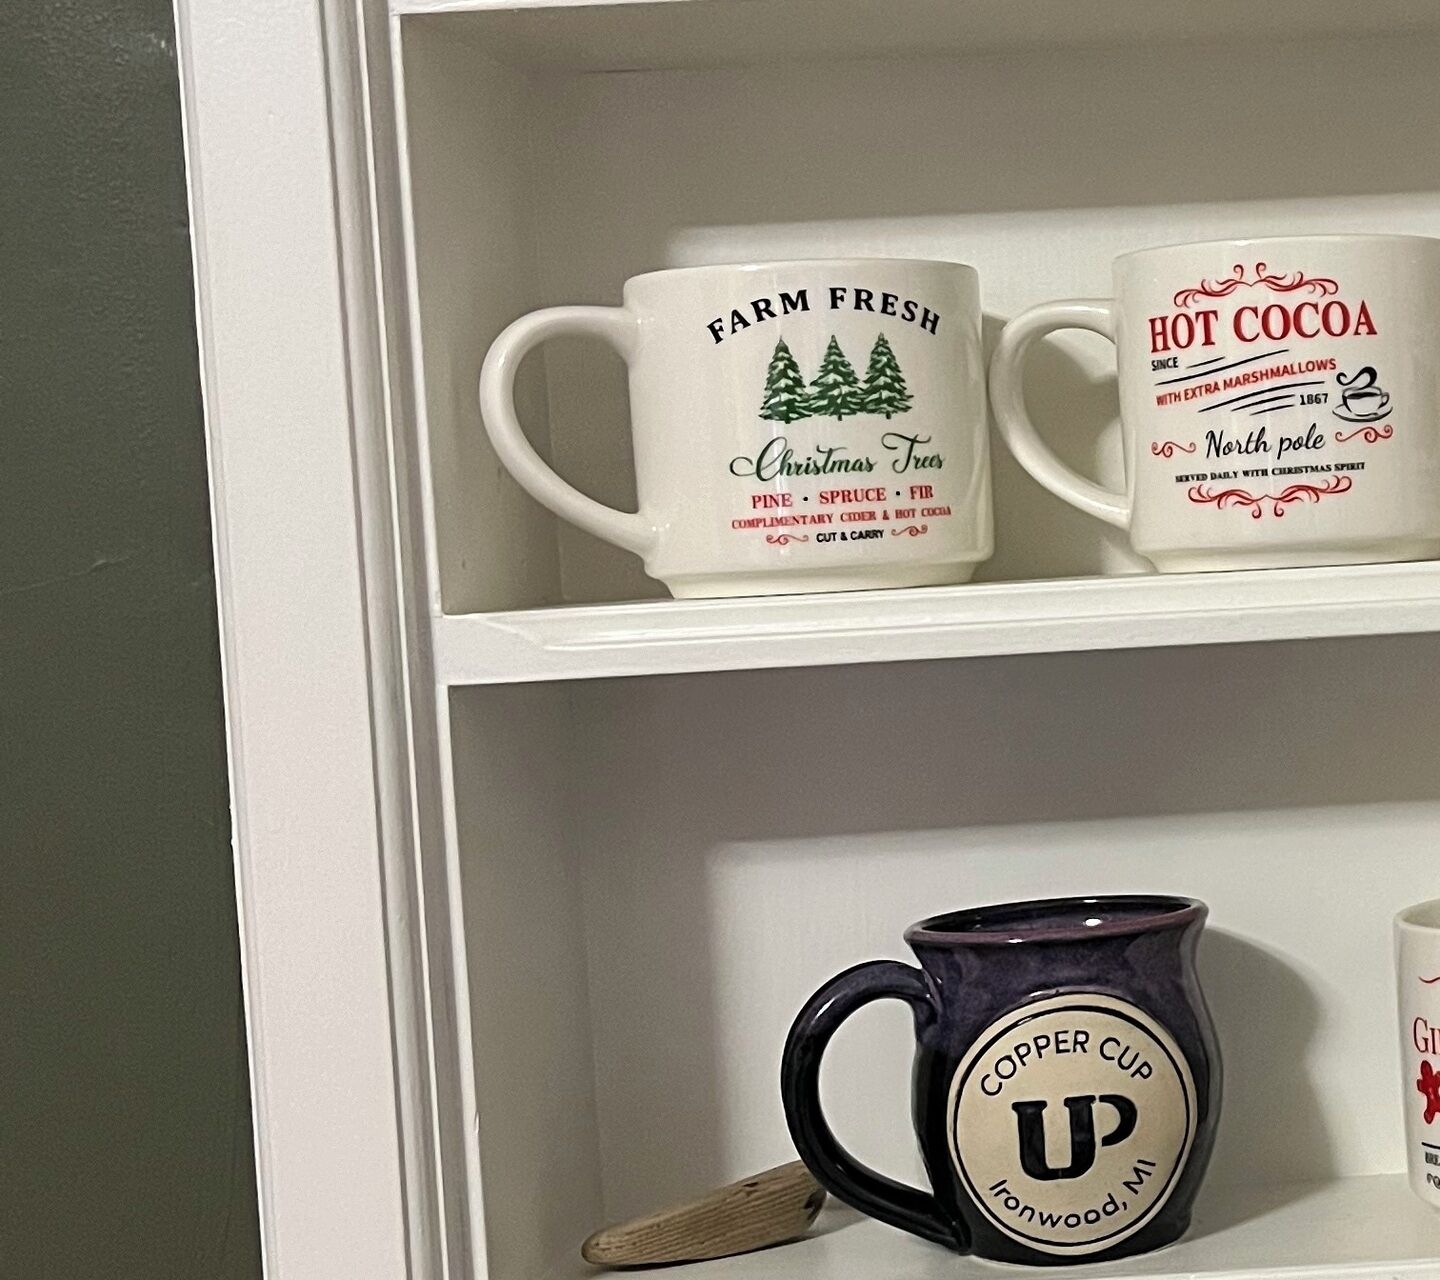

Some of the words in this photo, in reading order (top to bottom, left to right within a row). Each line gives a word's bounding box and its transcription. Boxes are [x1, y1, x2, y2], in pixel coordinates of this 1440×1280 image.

[707, 288, 810, 344] FARM
[829, 287, 941, 335] FRESH
[1148, 310, 1218, 354] HOT
[1232, 299, 1378, 343] COCOA
[1151, 357, 1179, 372] SINCE
[1155, 390, 1182, 406] WITH
[1184, 382, 1221, 402] EXTRA
[1223, 358, 1337, 393] MARSHMALLOWS
[1299, 393, 1329, 405] 1867
[729, 436, 878, 482] Christmas
[881, 432, 945, 474] Trees
[1205, 426, 1270, 459] North
[1277, 423, 1326, 460] pole
[1175, 472, 1208, 483] SERVED
[1210, 470, 1238, 481] DAILY
[1243, 468, 1269, 477] WITH
[1271, 463, 1332, 476] CHRISTMAS
[1334, 462, 1365, 471] SPIRIT
[751, 493, 793, 509] PINE
[819, 487, 887, 505] SPRUCE
[910, 485, 934, 500] FIR
[731, 513, 833, 529] COMPLIMENTARY
[840, 511, 876, 522] CIDER
[895, 508, 917, 519] HOT
[921, 506, 952, 517] COCOA
[816, 532, 837, 543] CUT
[840, 532, 847, 541] &
[850, 530, 885, 540] CARRY
[980, 1029, 1090, 1096] COPPER
[1099, 1037, 1153, 1080] CUP
[989, 1179, 1129, 1229] Ironwood,
[1122, 1158, 1157, 1195] MI
